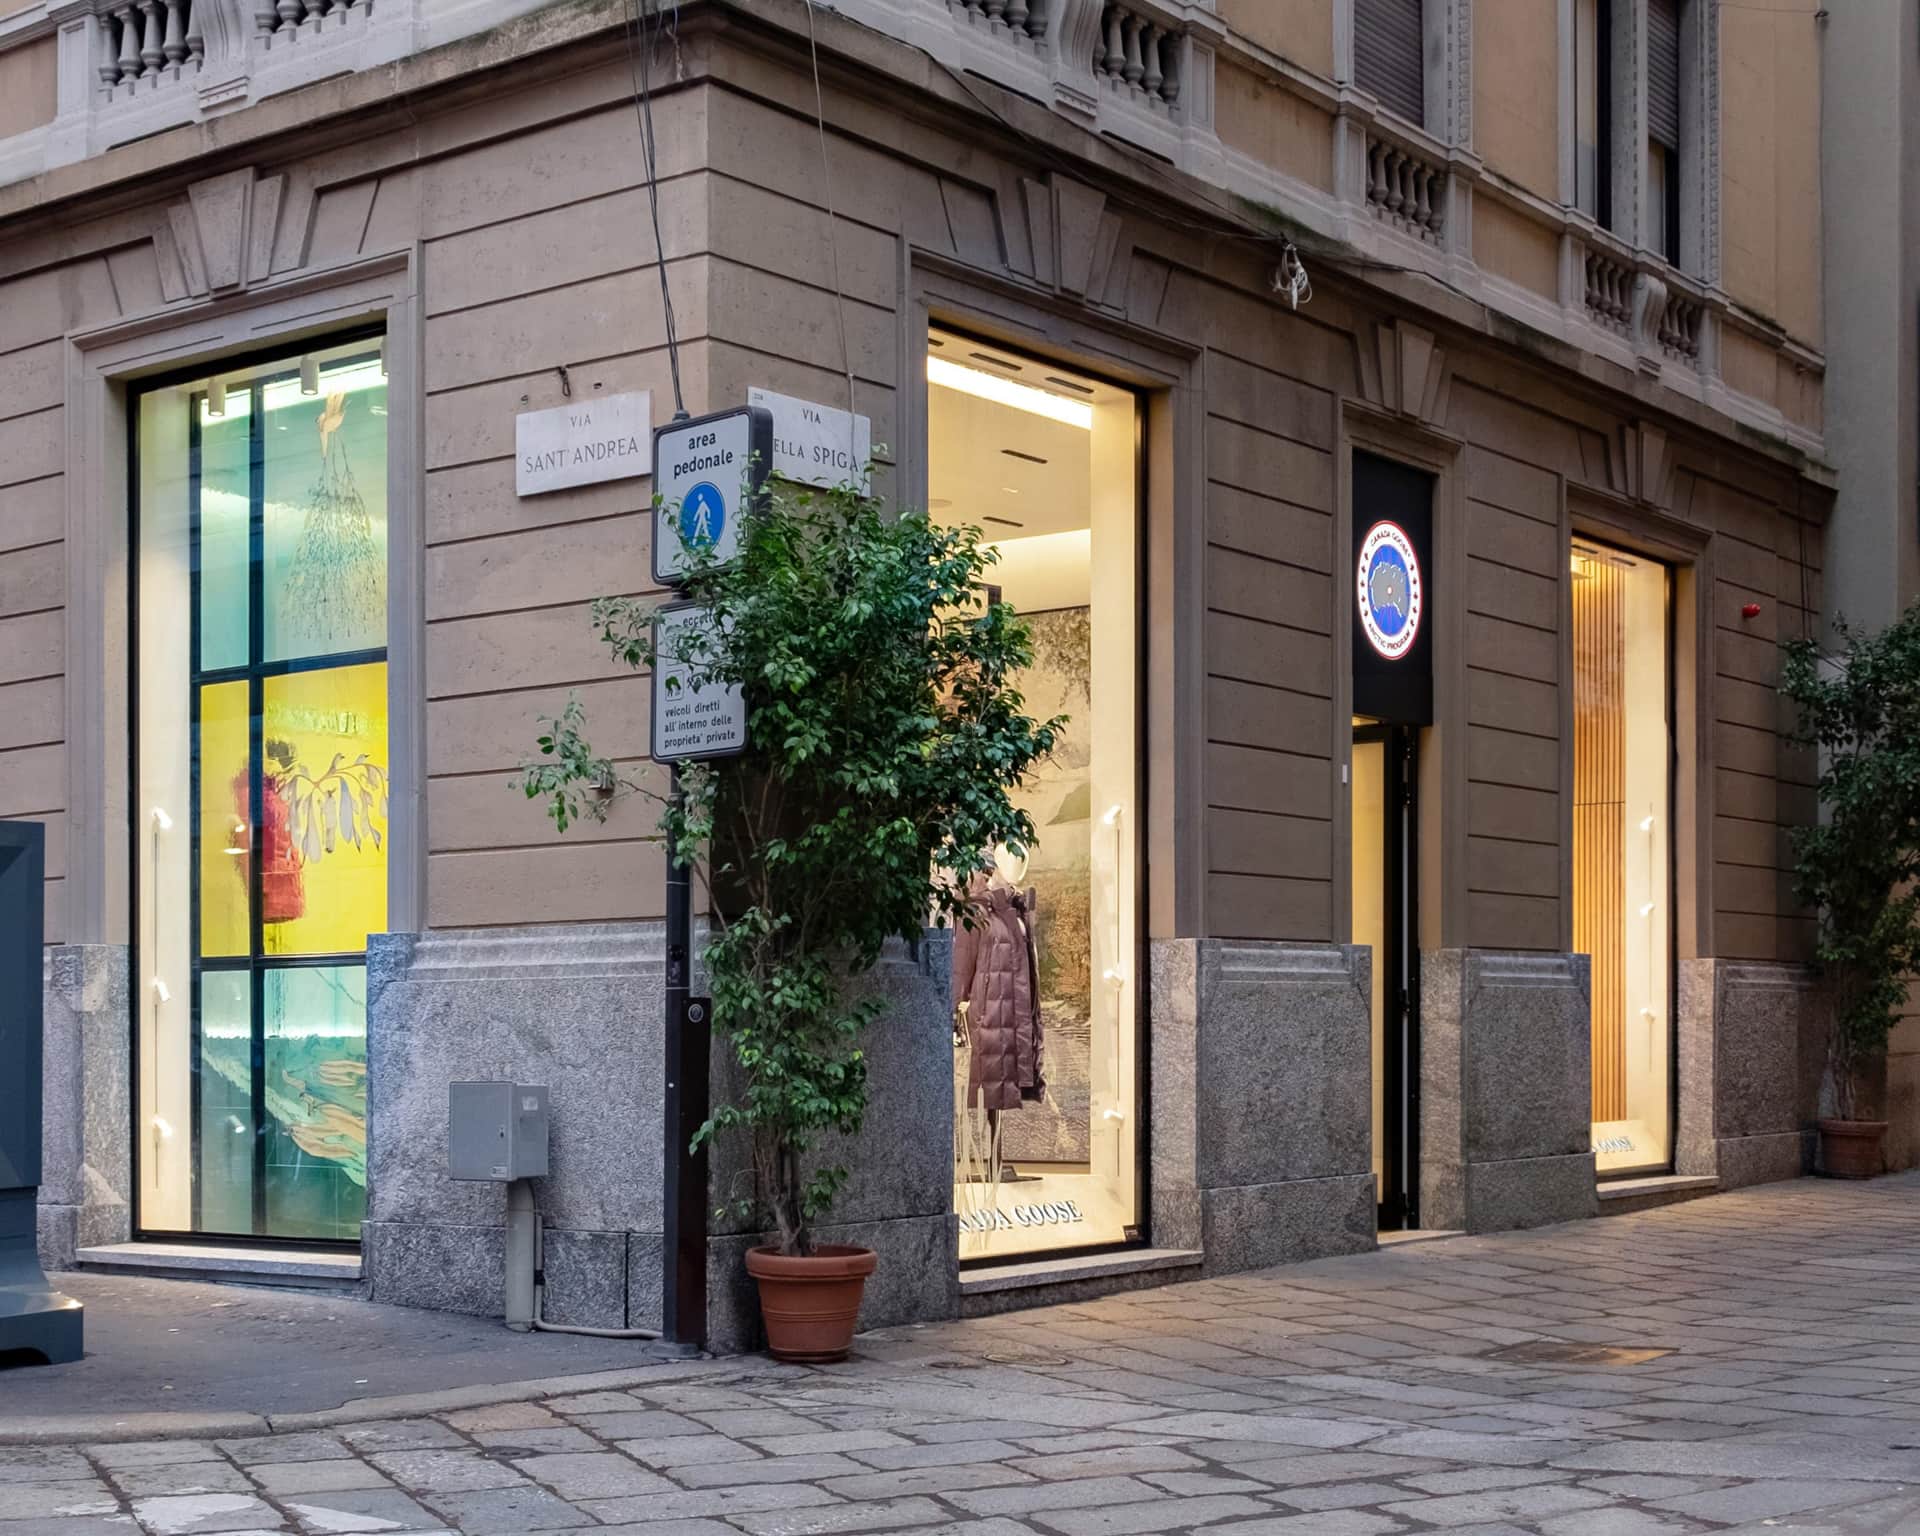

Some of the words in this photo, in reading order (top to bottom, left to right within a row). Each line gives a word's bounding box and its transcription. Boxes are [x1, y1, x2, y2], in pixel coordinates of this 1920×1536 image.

[569, 413, 592, 428] VIA
[802, 408, 822, 425] VIA
[688, 432, 717, 450] area
[673, 448, 733, 479] pedonale
[773, 437, 805, 459] ELLA
[813, 445, 859, 473] SPIGA
[664, 703, 691, 718] veicoli
[694, 699, 720, 714] diretti
[711, 714, 732, 727] delle
[706, 730, 735, 745] private
[1013, 1199, 1083, 1228] GOOSE
